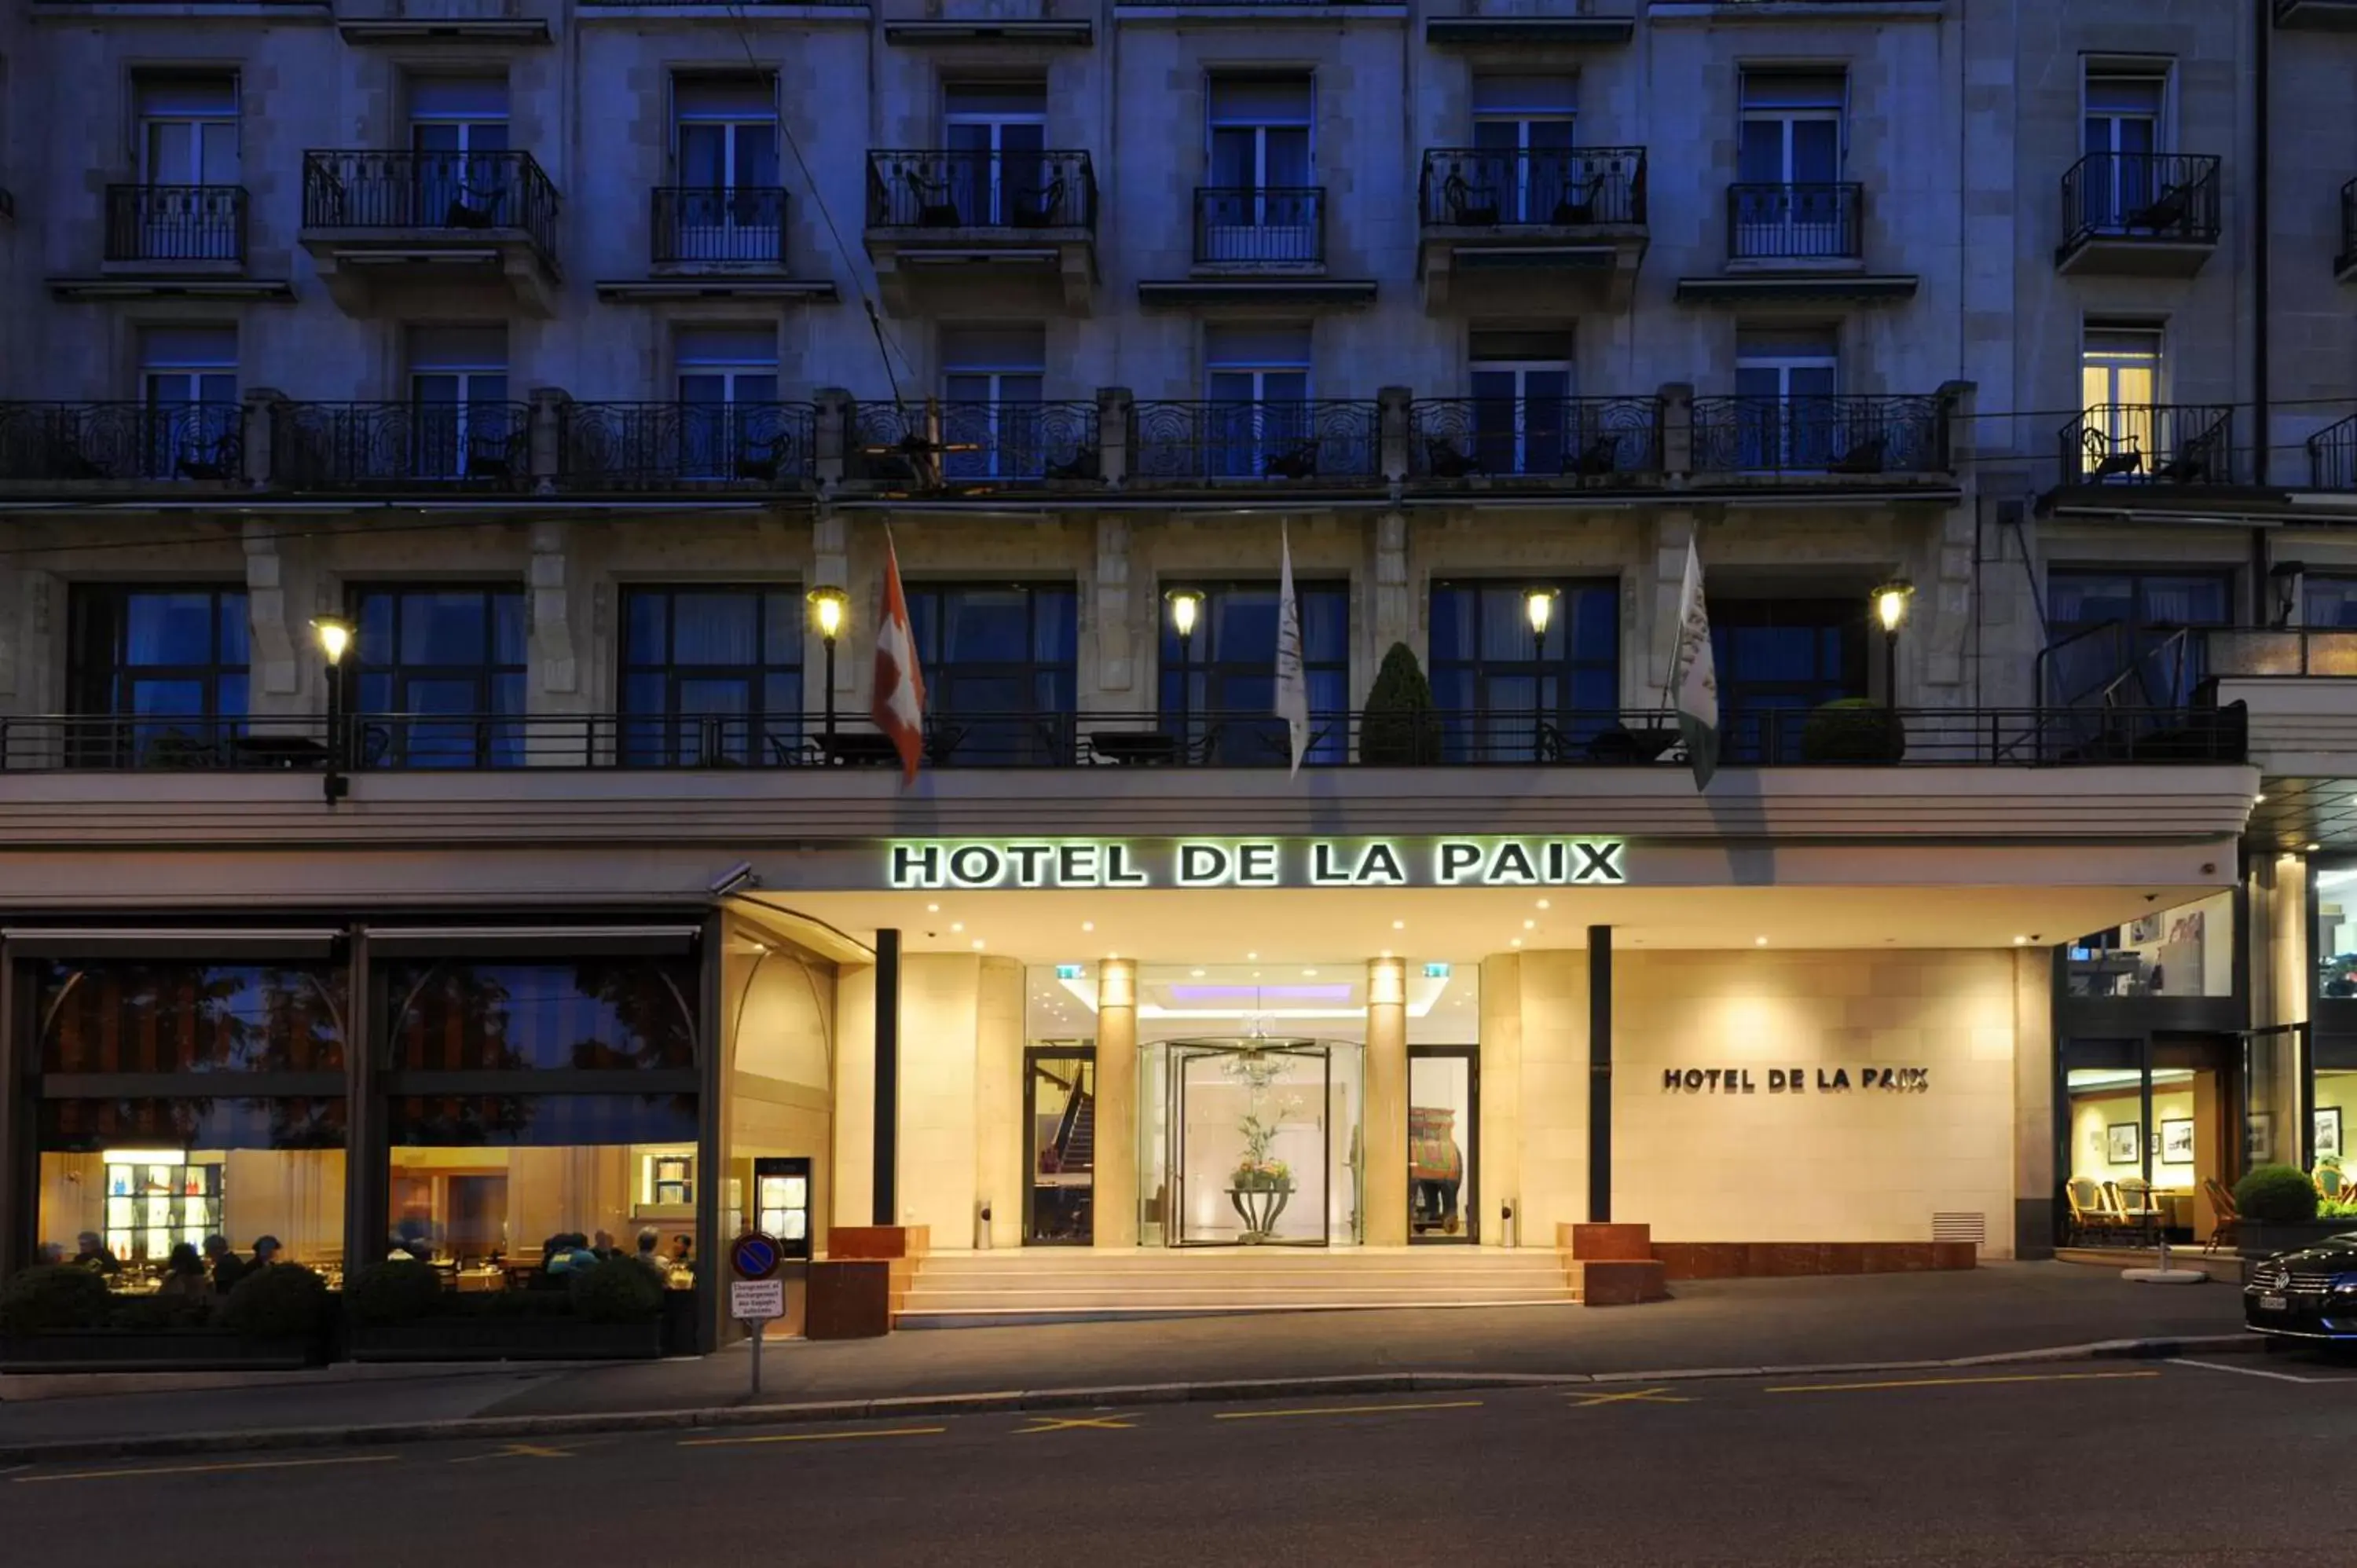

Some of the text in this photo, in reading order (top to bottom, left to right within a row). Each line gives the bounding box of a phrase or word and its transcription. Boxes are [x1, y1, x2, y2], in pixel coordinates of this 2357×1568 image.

[893, 842, 1623, 884] HOTEL DE LA PAIX
[1663, 1067, 1930, 1090] HOTEL DE LA PAIX
